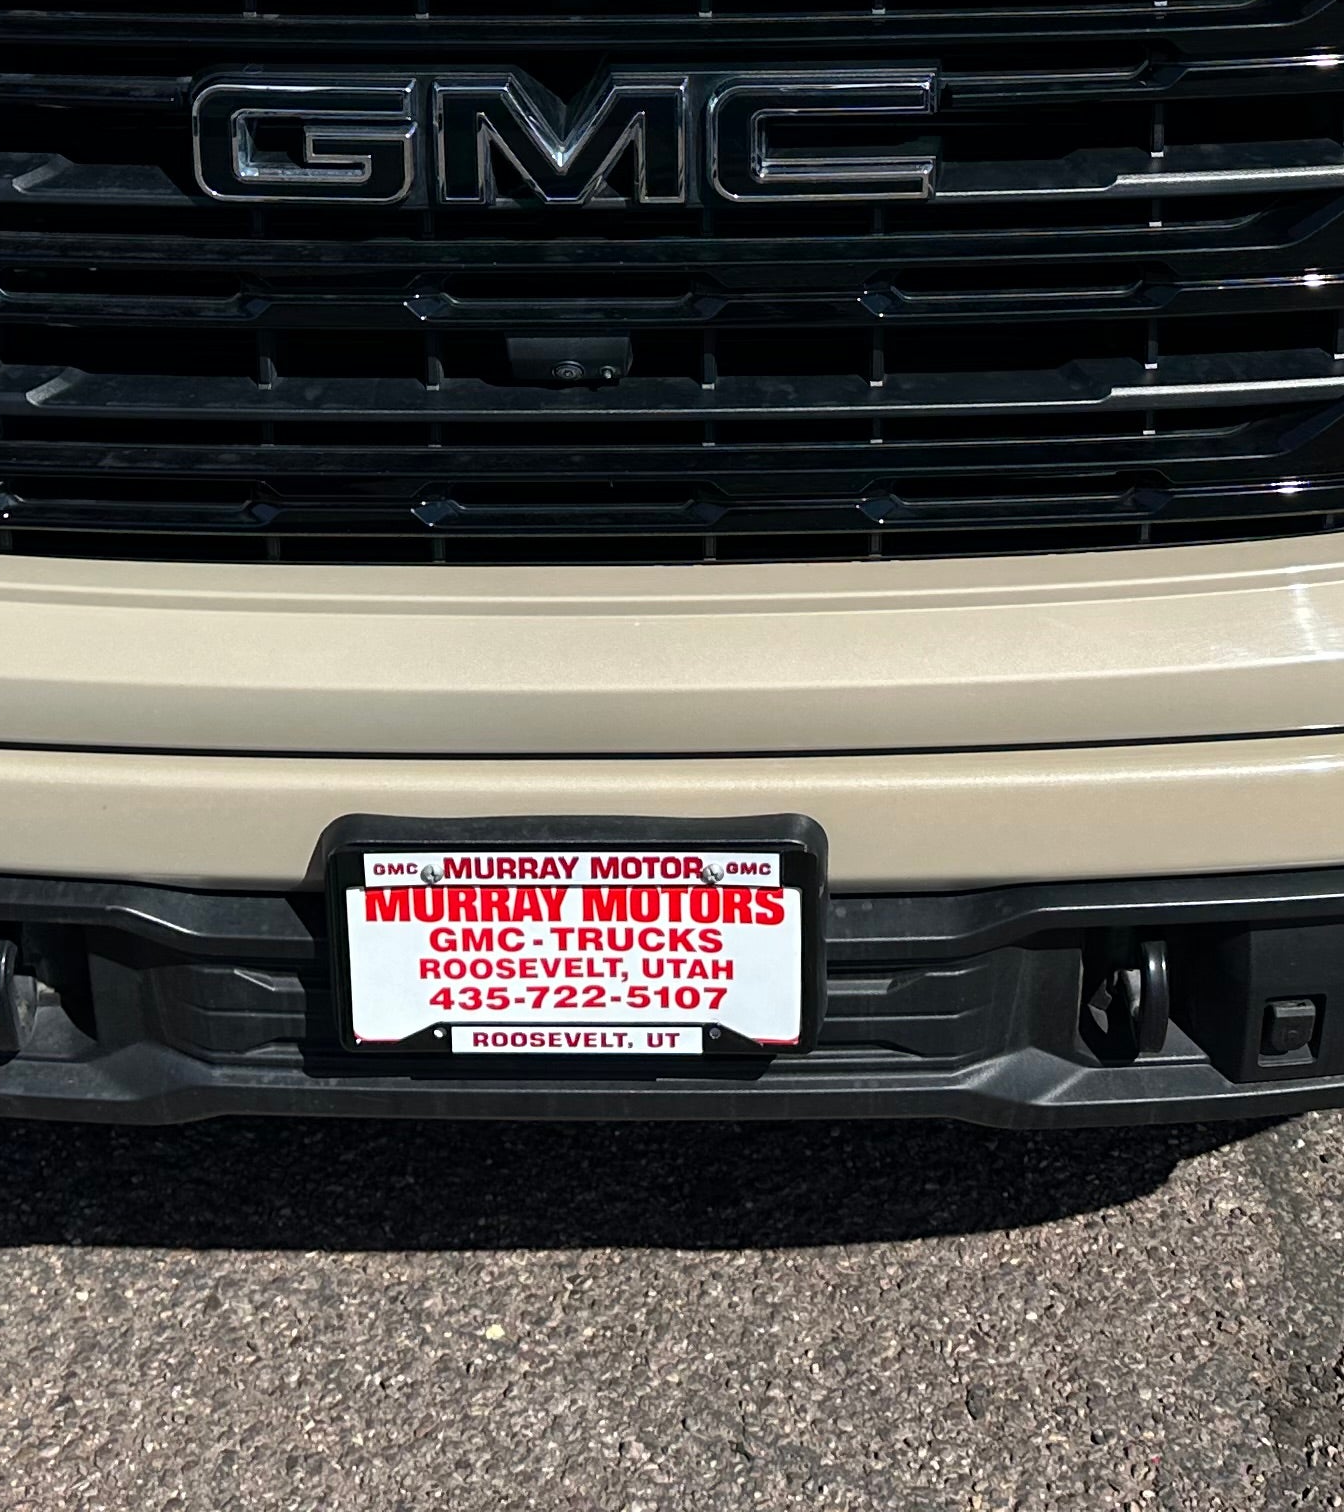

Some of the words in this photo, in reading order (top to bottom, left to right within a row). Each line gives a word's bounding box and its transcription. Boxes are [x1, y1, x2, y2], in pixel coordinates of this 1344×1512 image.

[190, 70, 939, 205] GMC
[373, 863, 418, 875] GMC
[443, 856, 579, 879] MURRAY
[591, 856, 703, 879] MOTOR
[726, 862, 772, 875] GMC
[365, 886, 567, 922] MURRAY
[582, 886, 785, 925] MOTORS
[419, 957, 629, 982] ROOSEVELT,
[642, 957, 734, 980] UTAH
[429, 985, 728, 1010] 435-722-5107
[472, 1031, 633, 1048] ROOSEVELT,
[647, 1032, 680, 1048] UT
